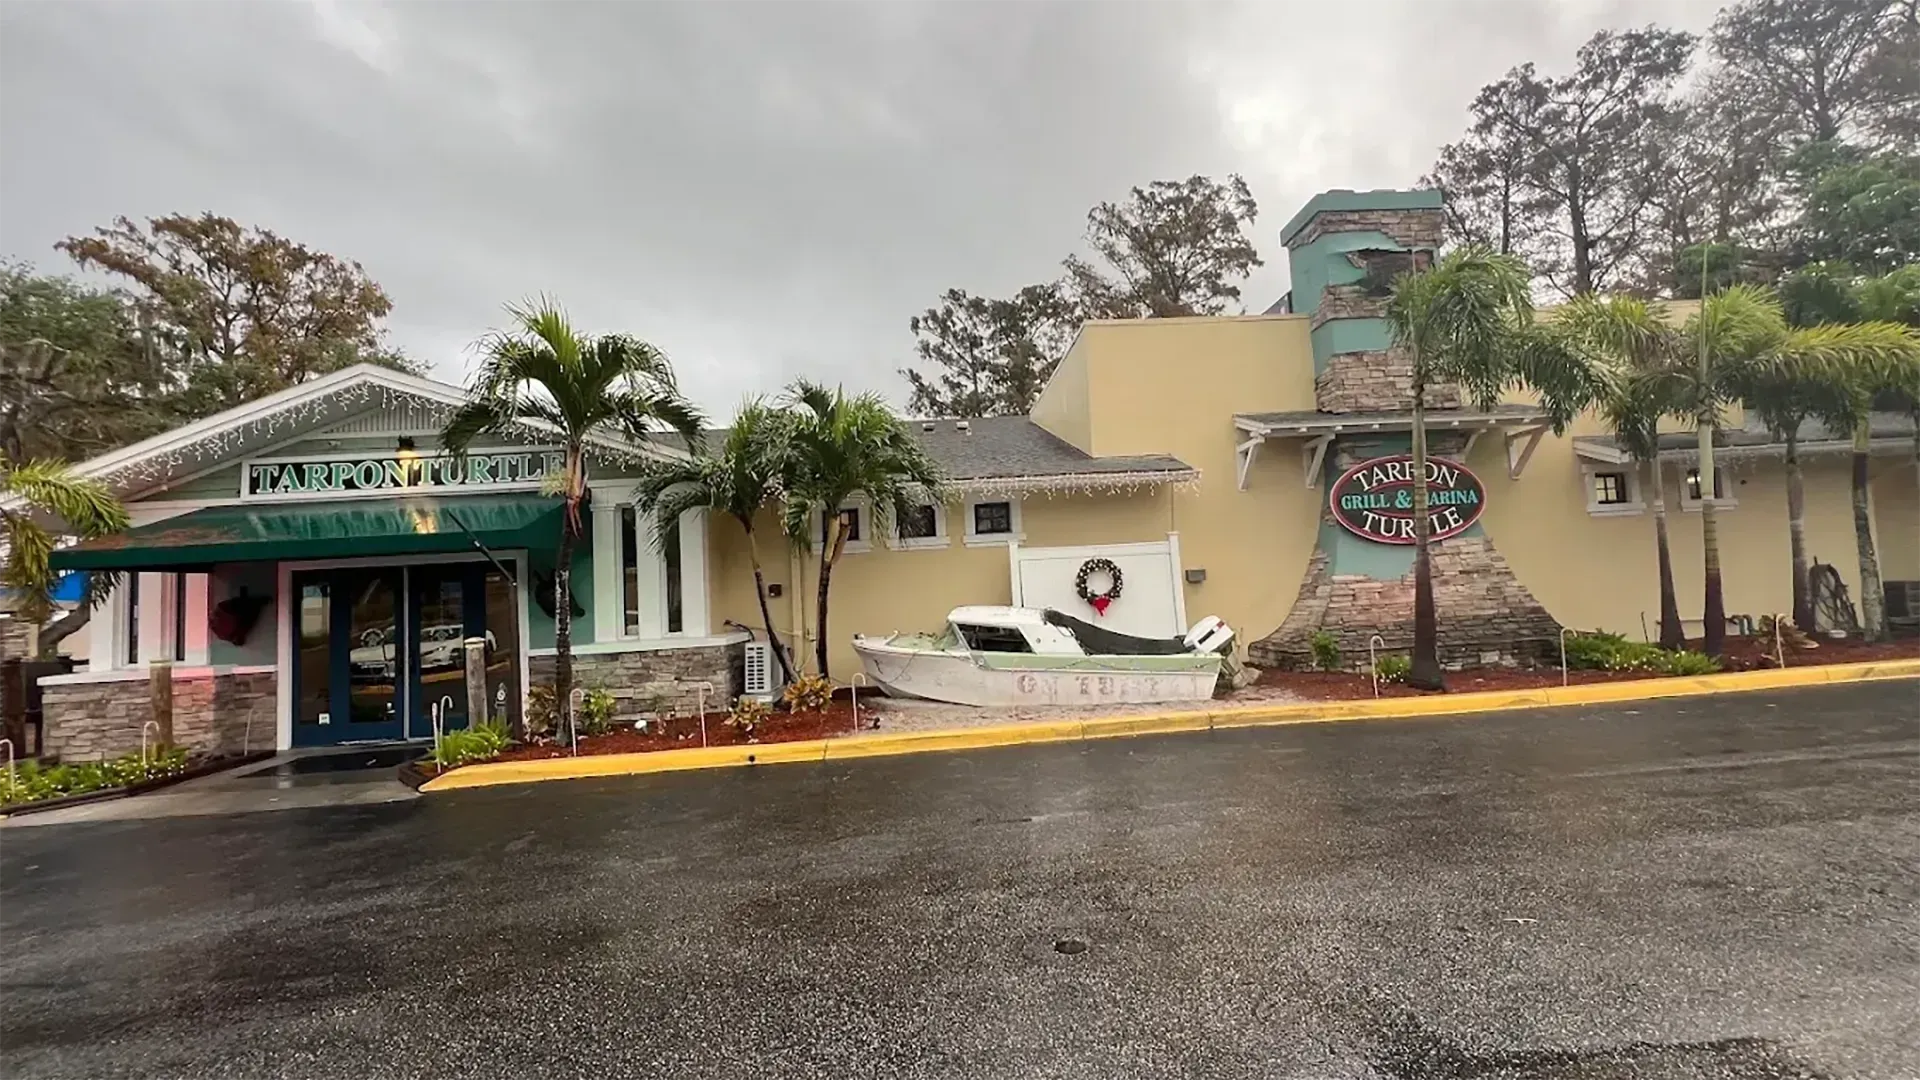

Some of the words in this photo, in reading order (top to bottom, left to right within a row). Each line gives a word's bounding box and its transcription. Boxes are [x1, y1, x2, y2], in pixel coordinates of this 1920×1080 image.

[251, 458, 413, 494] TARPON
[413, 452, 566, 487] TURTLE
[1341, 493, 1390, 510] GRILL
[1395, 489, 1413, 509] &
[1419, 489, 1479, 507] ARINA
[1362, 506, 1464, 539] TURLE
